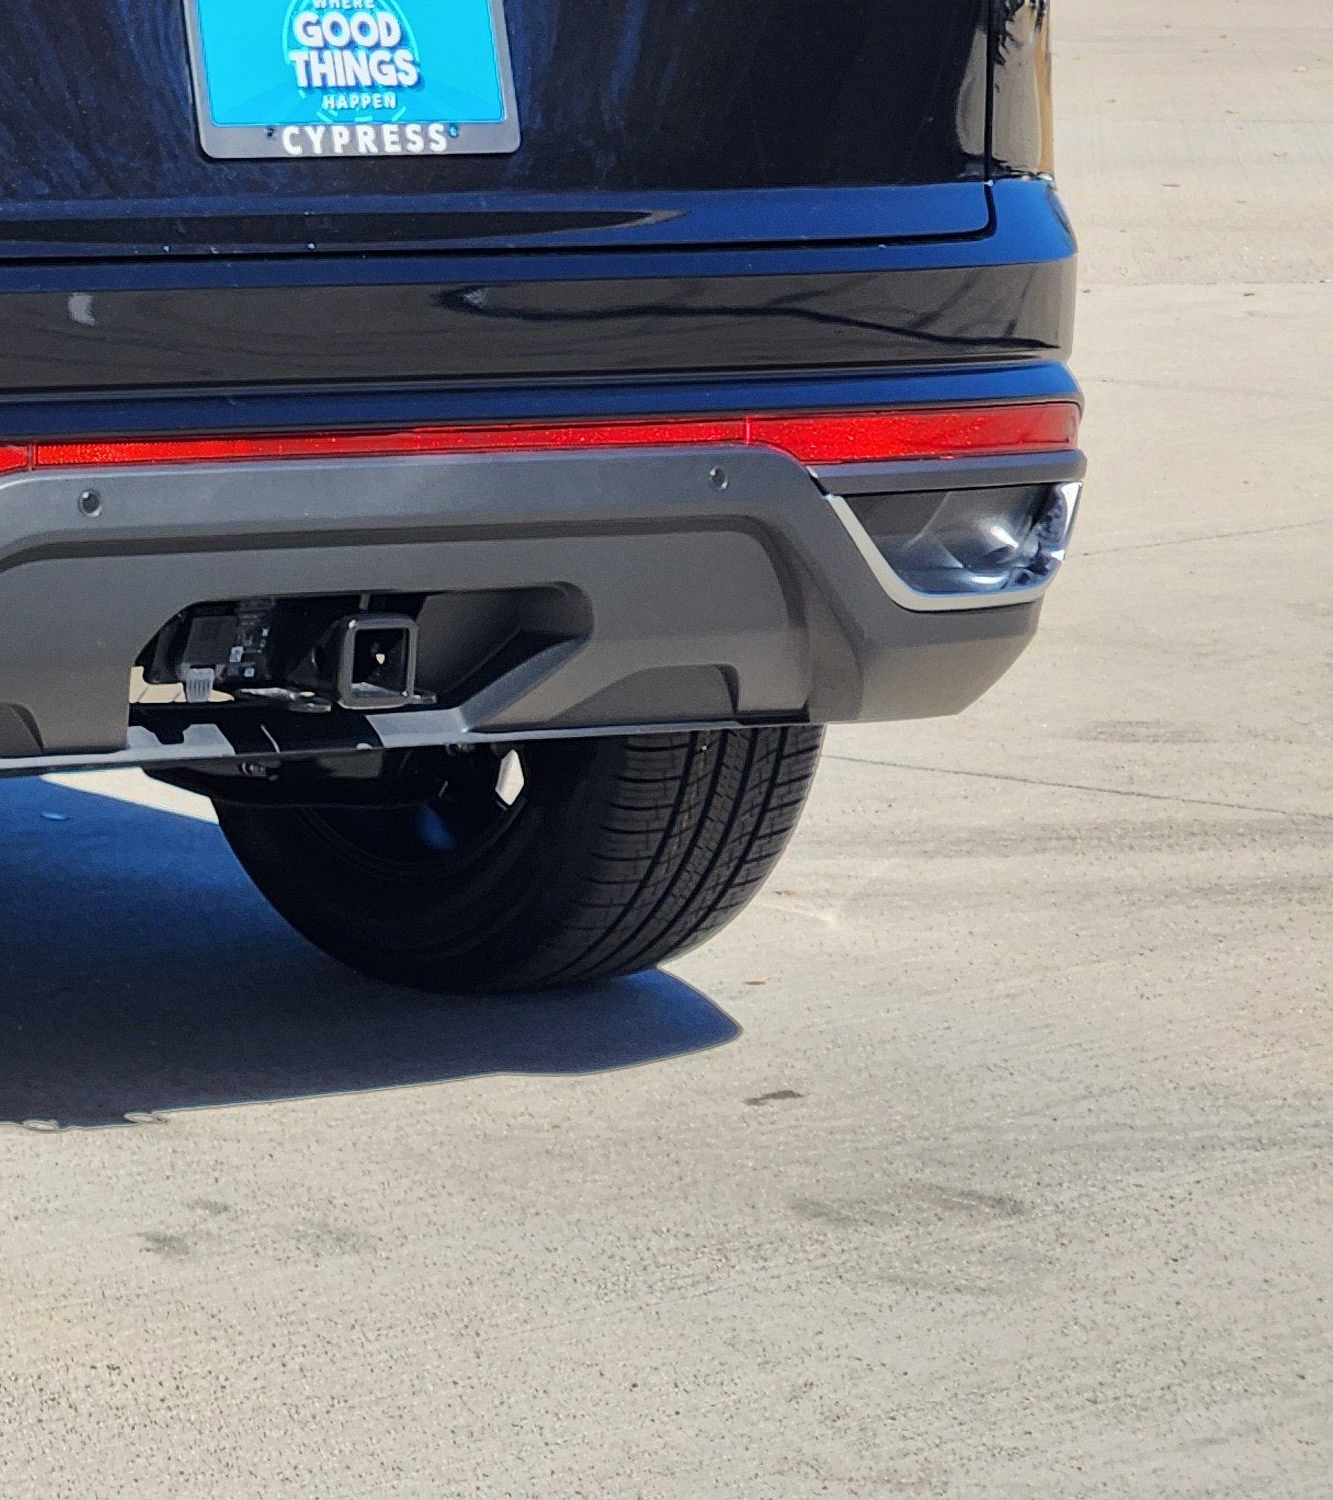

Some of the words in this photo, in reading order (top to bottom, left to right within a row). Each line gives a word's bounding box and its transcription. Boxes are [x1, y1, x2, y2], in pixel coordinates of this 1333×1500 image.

[294, 11, 402, 48] GOOD
[288, 48, 419, 88] THINGS
[323, 92, 397, 109] HAPPEN
[282, 123, 448, 156] CYPRESS
